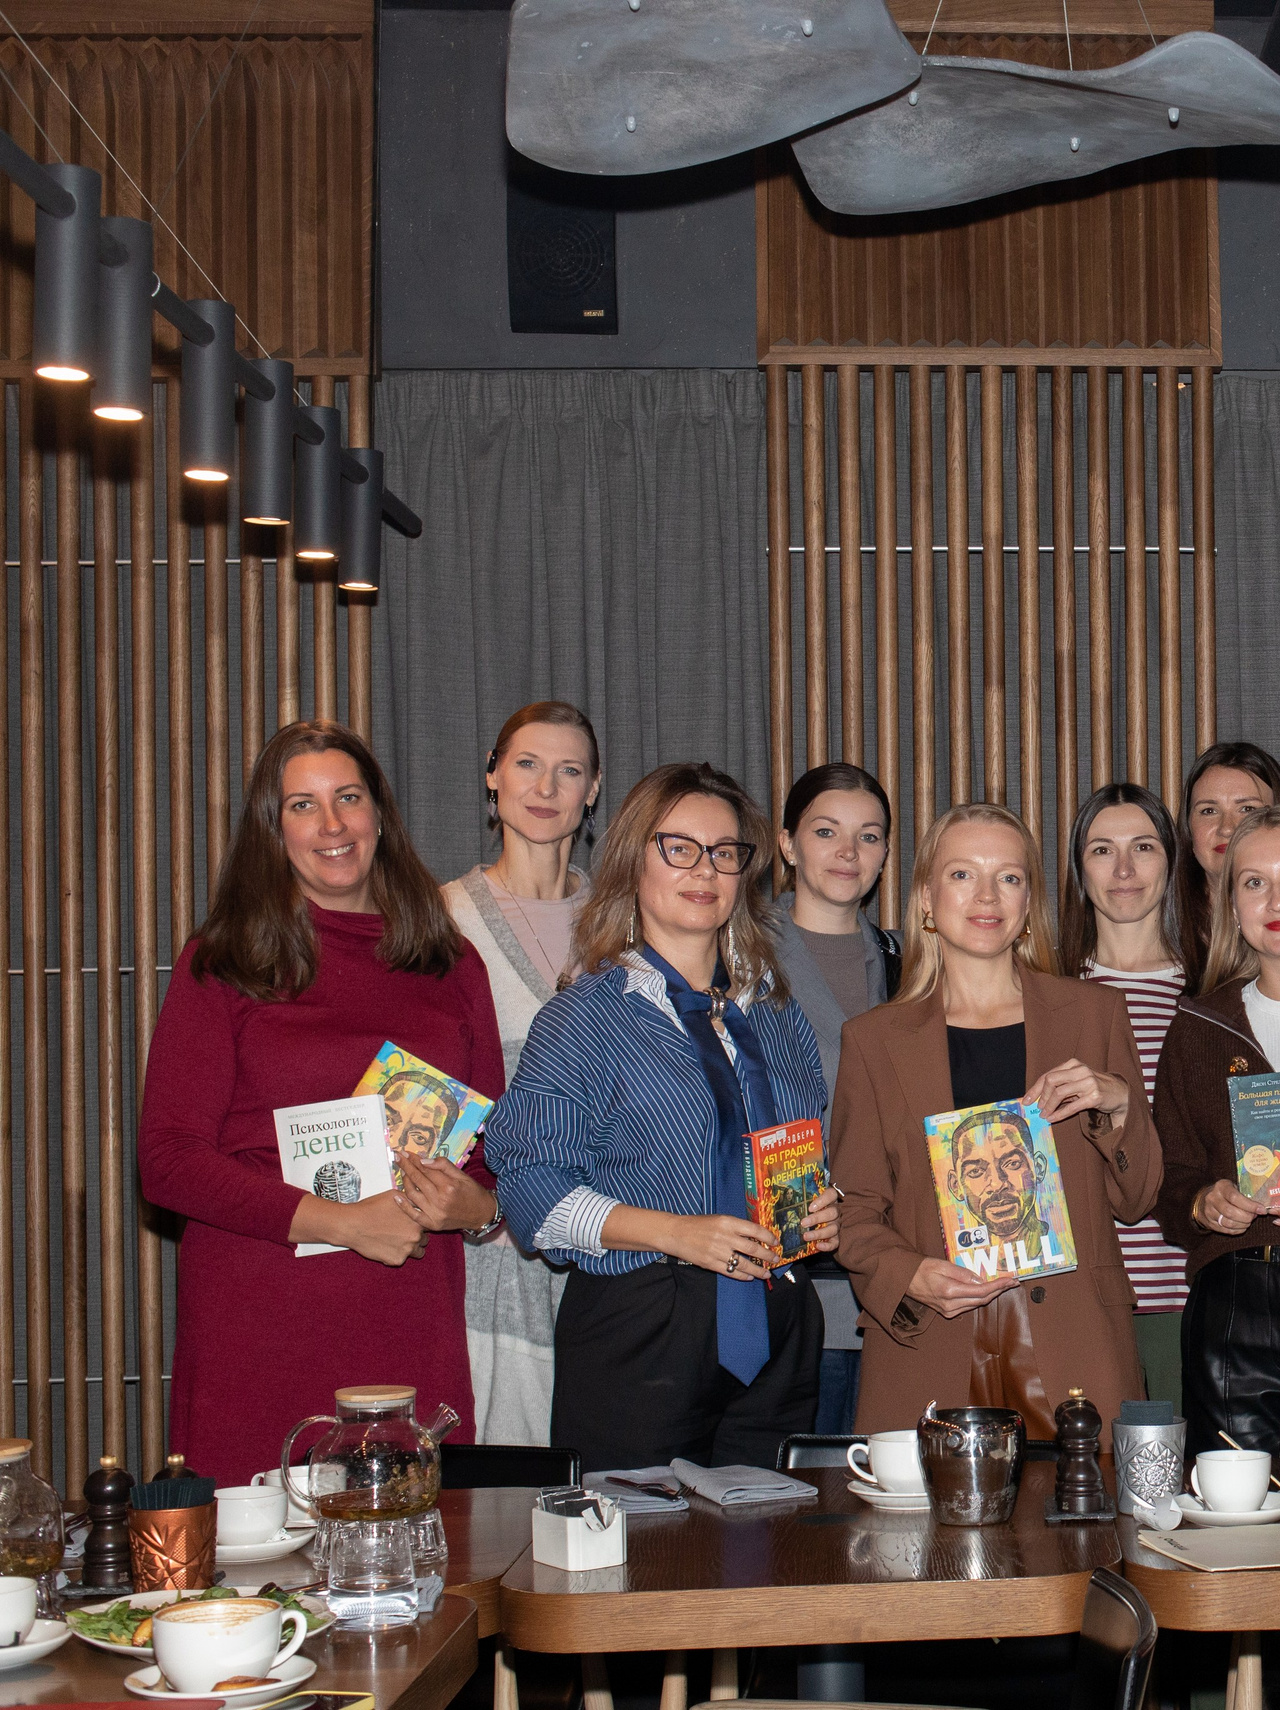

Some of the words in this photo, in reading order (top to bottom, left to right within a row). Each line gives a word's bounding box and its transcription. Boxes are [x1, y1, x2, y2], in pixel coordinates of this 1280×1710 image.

[1238, 1090, 1272, 1100] Большая
[290, 1117, 366, 1136] Психология
[293, 1130, 368, 1161] денег
[778, 1129, 814, 1147] БРЭДБЕРИ
[764, 1153, 778, 1165] 451
[780, 1141, 815, 1161] ГРАДУС
[764, 1162, 818, 1187] ФАРЕНГЕЙТУ
[784, 1159, 796, 1171] ПО
[960, 1235, 1065, 1276] WILL
